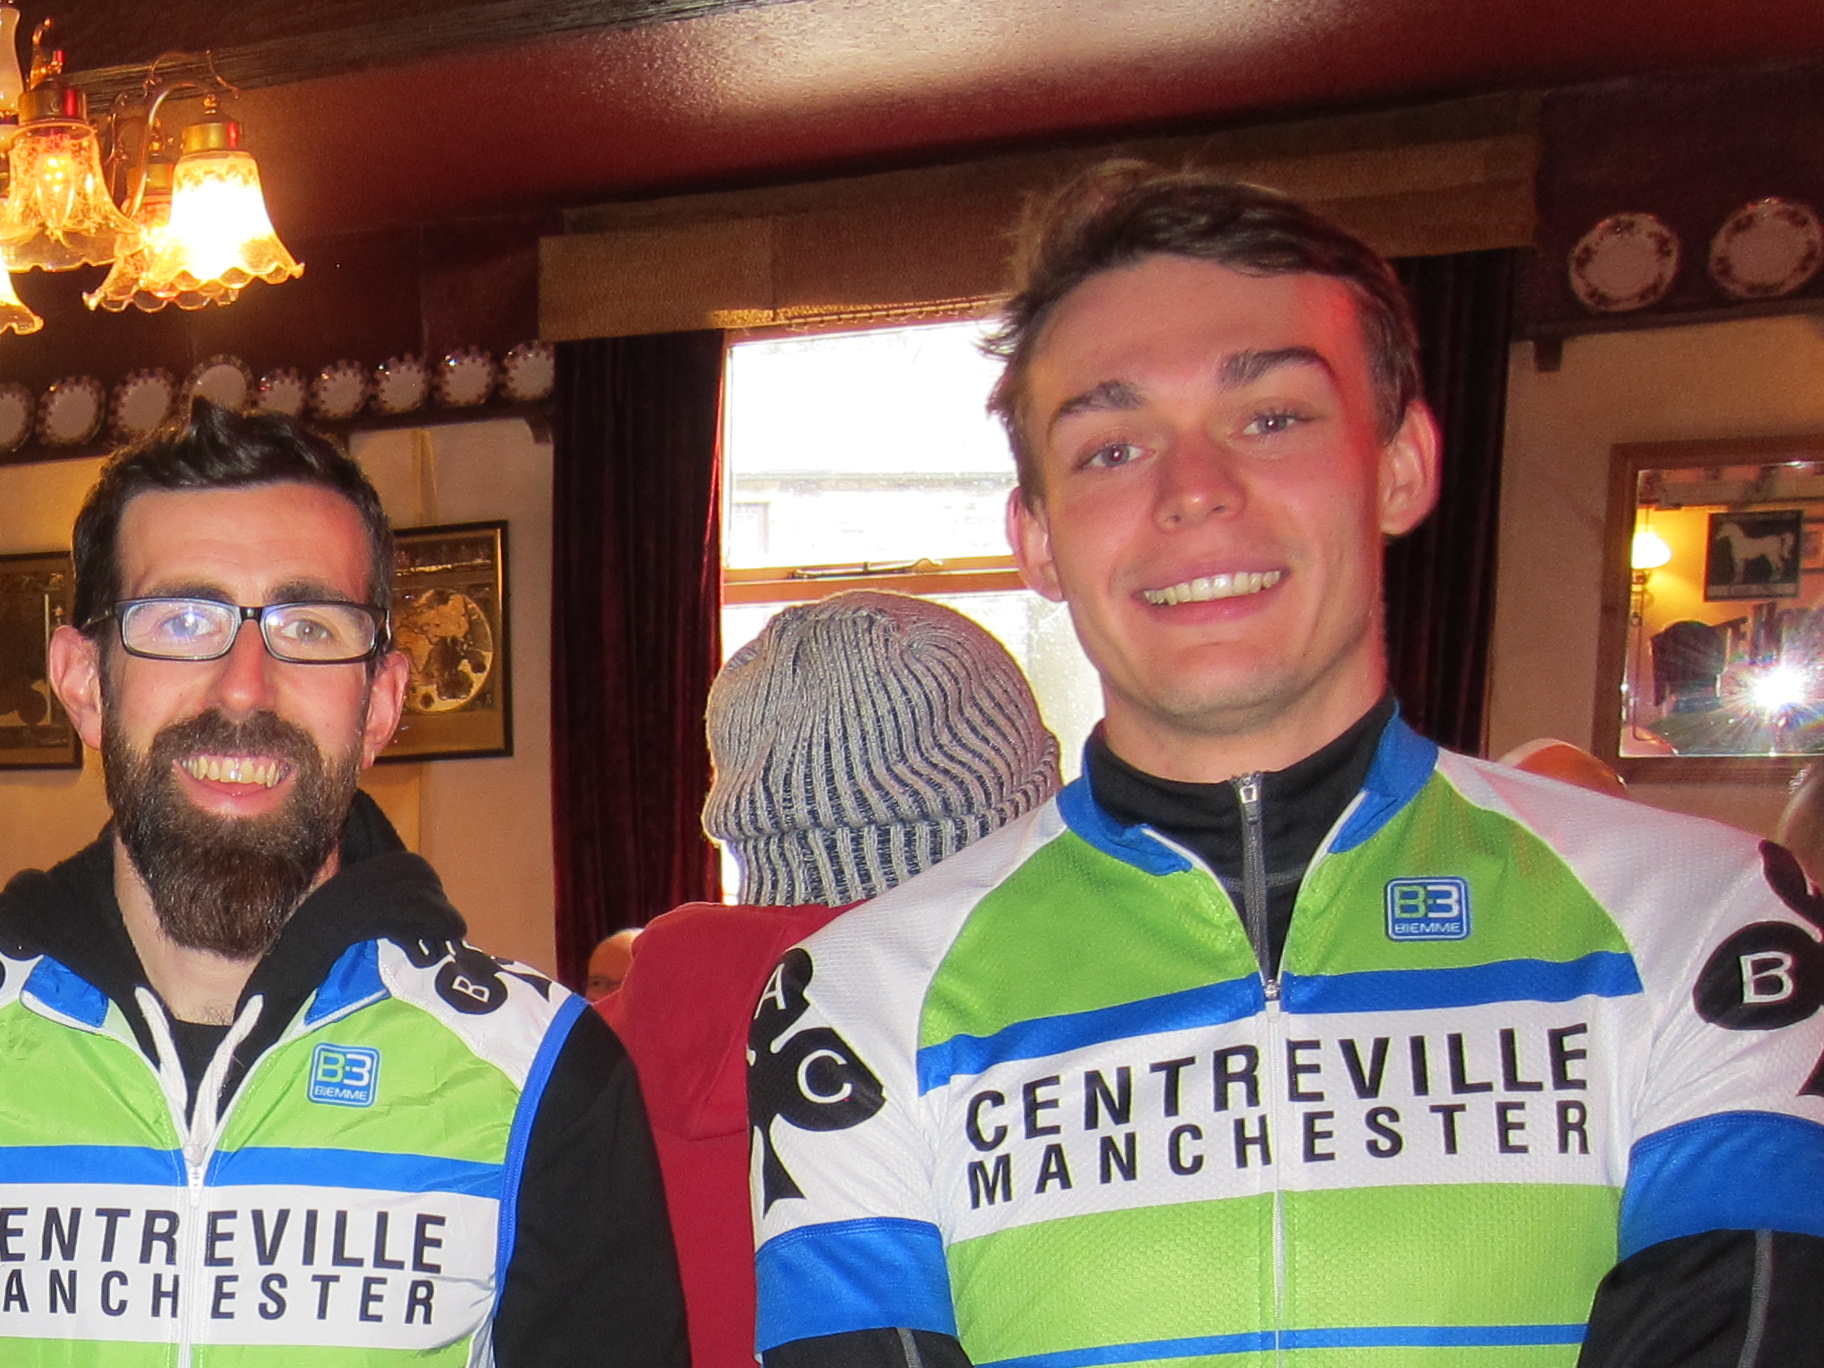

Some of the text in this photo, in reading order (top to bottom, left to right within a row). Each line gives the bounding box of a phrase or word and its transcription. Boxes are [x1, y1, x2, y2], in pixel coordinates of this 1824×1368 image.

[1395, 922, 1461, 934] BIEMME
[452, 975, 491, 1003] B
[1739, 951, 1794, 1005] B
[314, 1085, 368, 1101] BIEMME
[797, 1049, 853, 1104] C
[965, 1023, 1589, 1153] CENTREVILLE
[967, 1099, 1590, 1210] MANCHESTER
